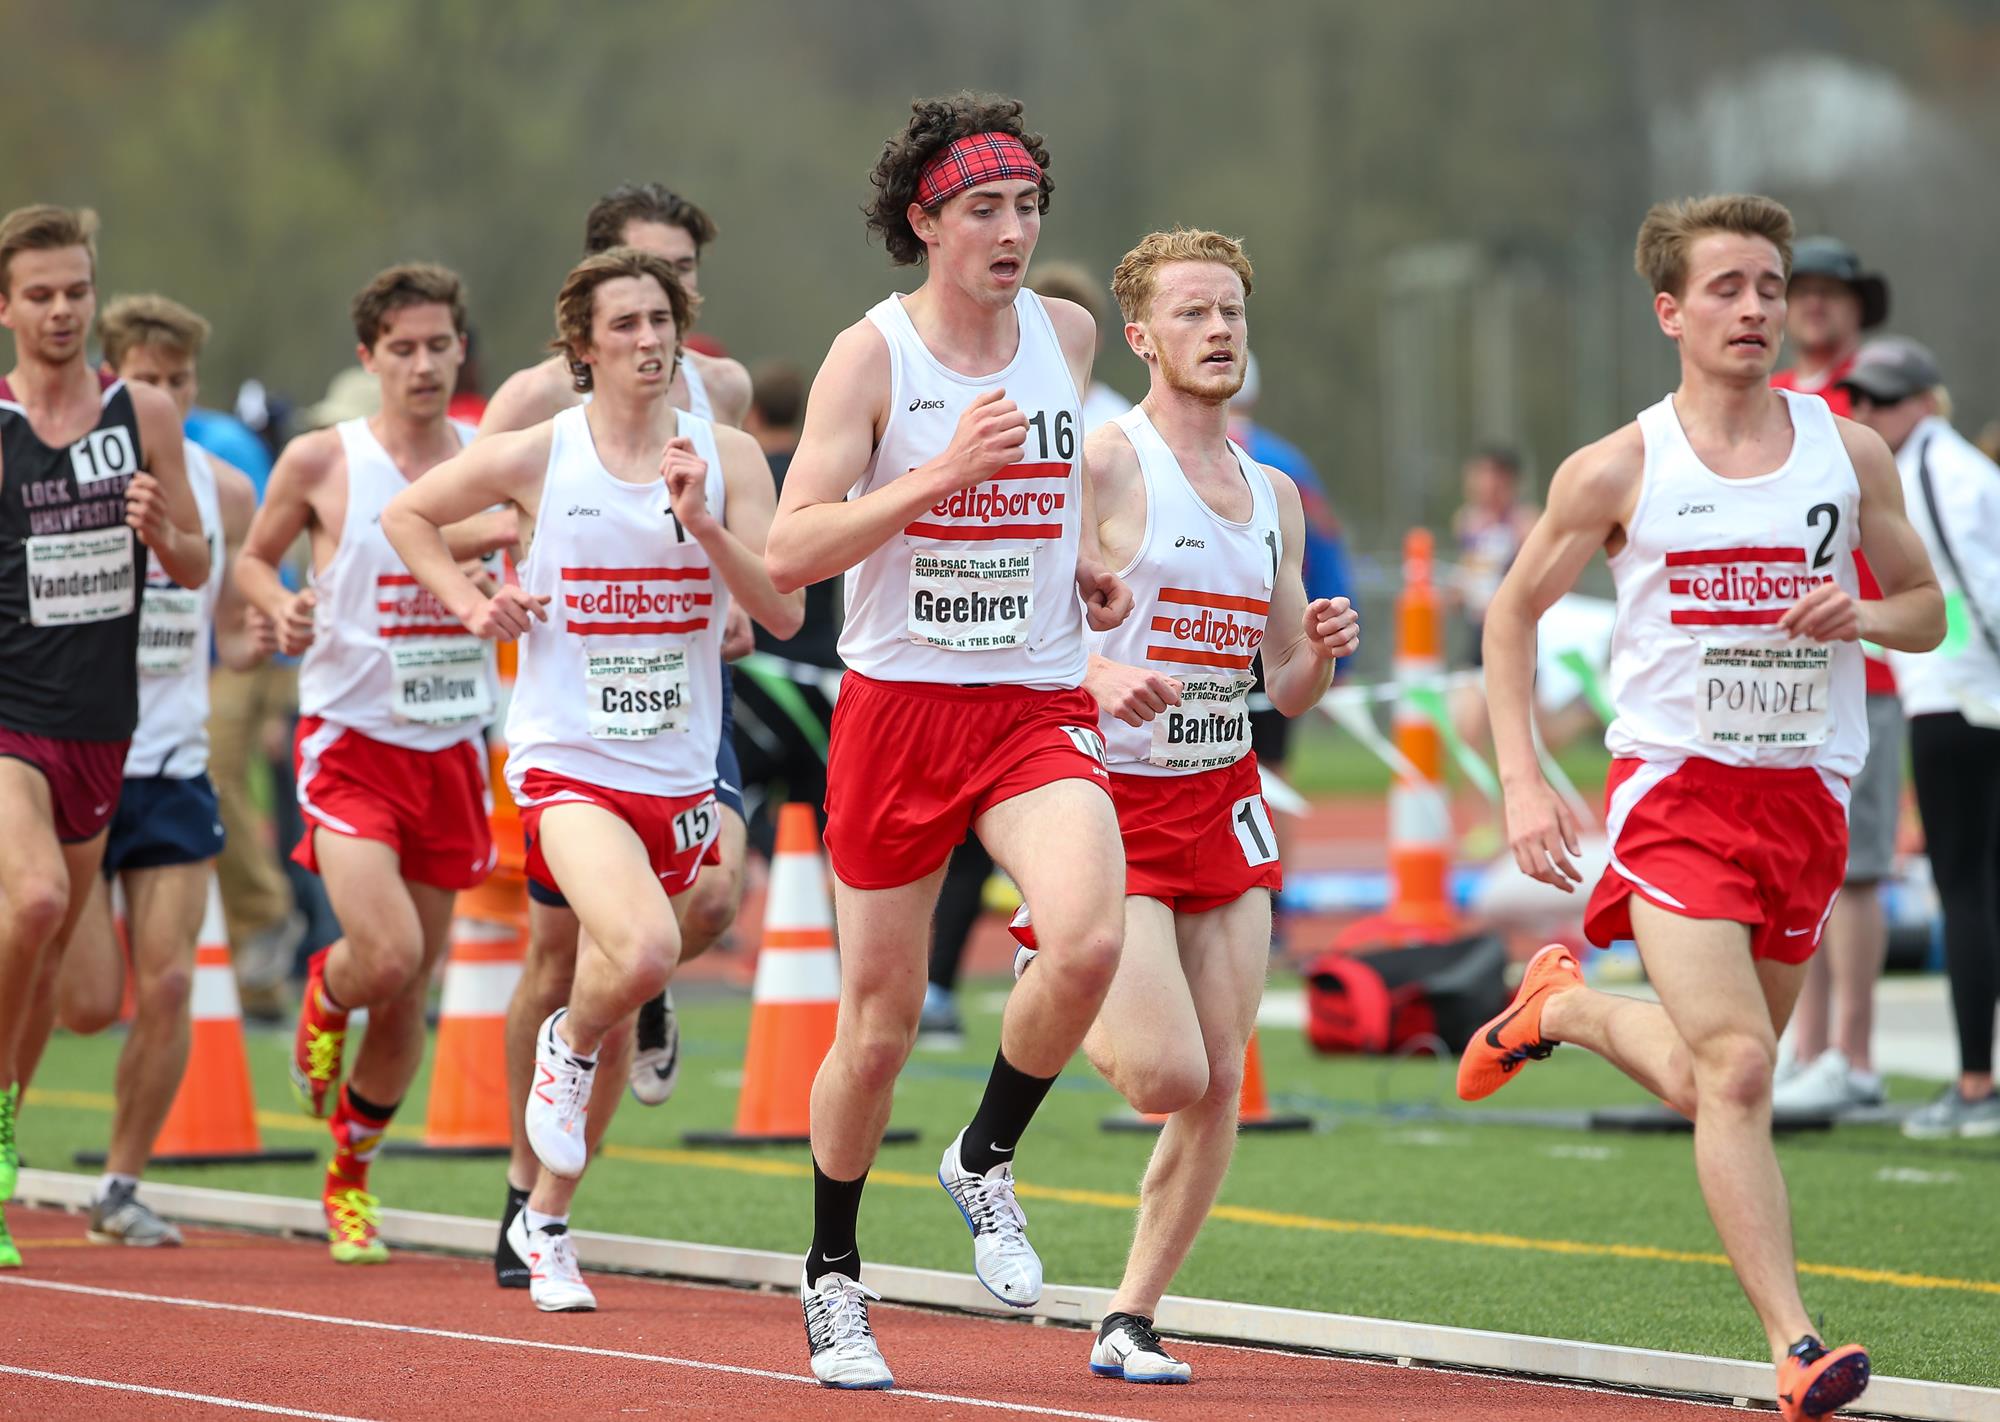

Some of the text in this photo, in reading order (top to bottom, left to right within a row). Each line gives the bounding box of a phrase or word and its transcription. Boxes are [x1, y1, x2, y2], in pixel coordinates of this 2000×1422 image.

[921, 400, 945, 410] asics
[1029, 410, 1075, 460] 16
[80, 434, 125, 476] 10
[21, 478, 72, 508] LOCK
[931, 484, 1053, 523] edinboro
[664, 506, 686, 543] 1
[1807, 503, 1840, 570] 2
[1186, 538, 1205, 549] asics
[1264, 530, 1277, 585] 1
[915, 556, 1029, 570] 2018 PSAC Track & Field
[915, 568, 1030, 579] SLIPPERY ROCK UNIVERSITY
[580, 585, 695, 619] edinboro
[914, 590, 1029, 623] Geehrer
[927, 635, 1016, 647] PSAC at THE ROCK
[602, 683, 681, 713] Cassel
[1187, 682, 1207, 691] PSAC
[1197, 692, 1218, 701] ROCK
[1707, 678, 1818, 713] PONDEL
[1166, 759, 1190, 768] PSAC
[1202, 758, 1216, 767] THE
[676, 801, 710, 848] 15
[1237, 802, 1270, 858] 1
